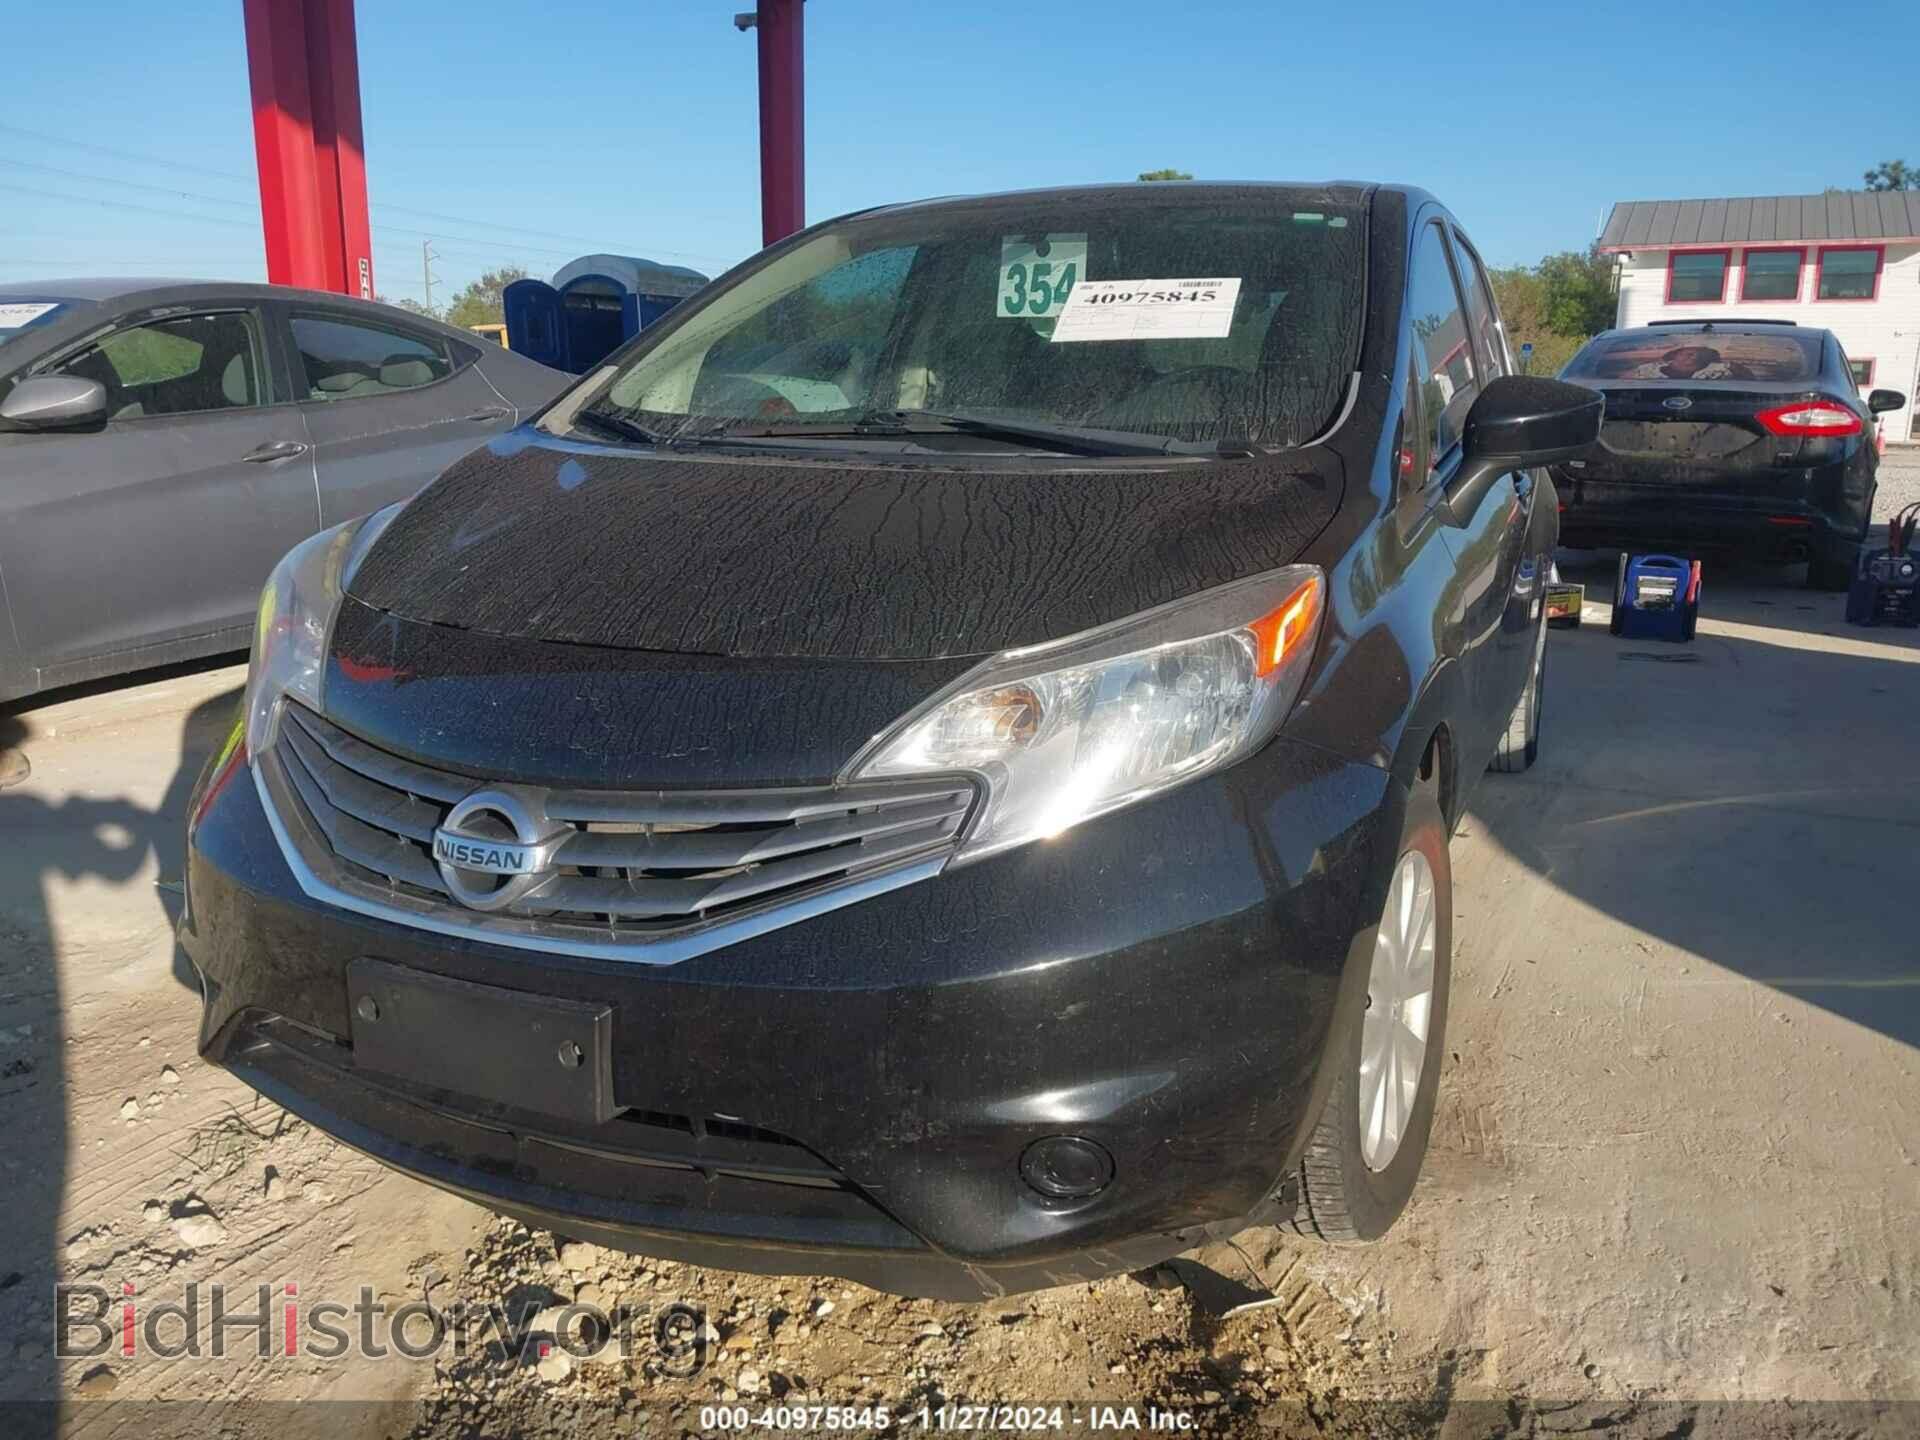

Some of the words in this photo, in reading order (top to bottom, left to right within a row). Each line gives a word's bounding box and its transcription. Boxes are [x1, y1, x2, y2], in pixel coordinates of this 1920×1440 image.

[1004, 263, 1076, 315] 354
[1084, 290, 1216, 305] 40975845
[437, 839, 524, 869] NISSAN
